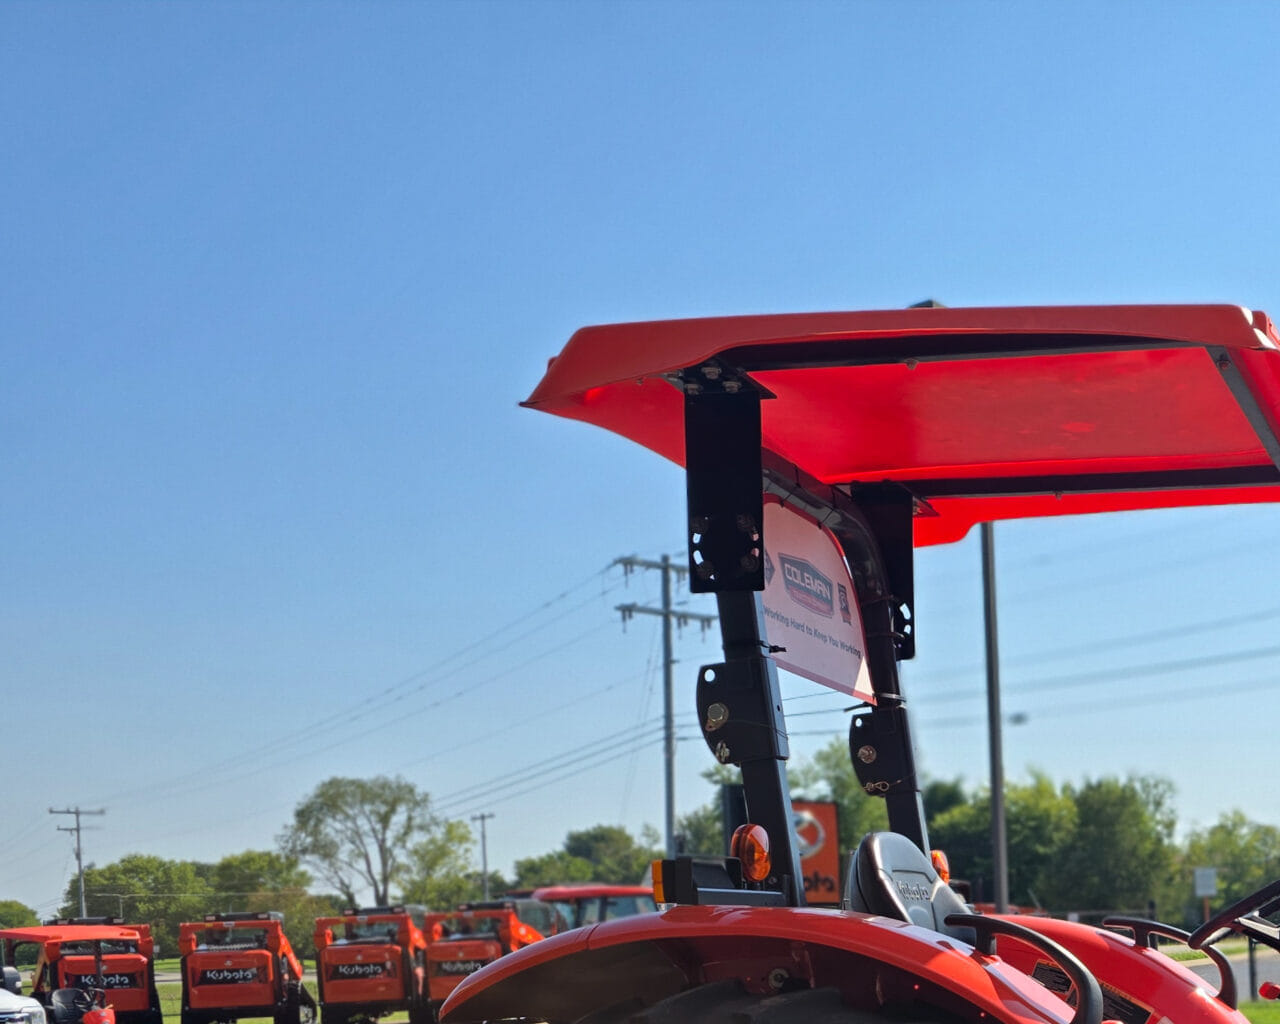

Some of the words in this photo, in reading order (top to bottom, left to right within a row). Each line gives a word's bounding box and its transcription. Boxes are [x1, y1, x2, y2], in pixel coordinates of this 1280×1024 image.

[784, 563, 831, 600] COLEMAN
[763, 606, 790, 627] Working
[790, 617, 805, 632] Hard
[814, 628, 828, 644] Keep
[828, 636, 839, 648] You
[840, 642, 862, 659] Working
[206, 969, 253, 980] Kubota
[338, 964, 383, 975] Kubota
